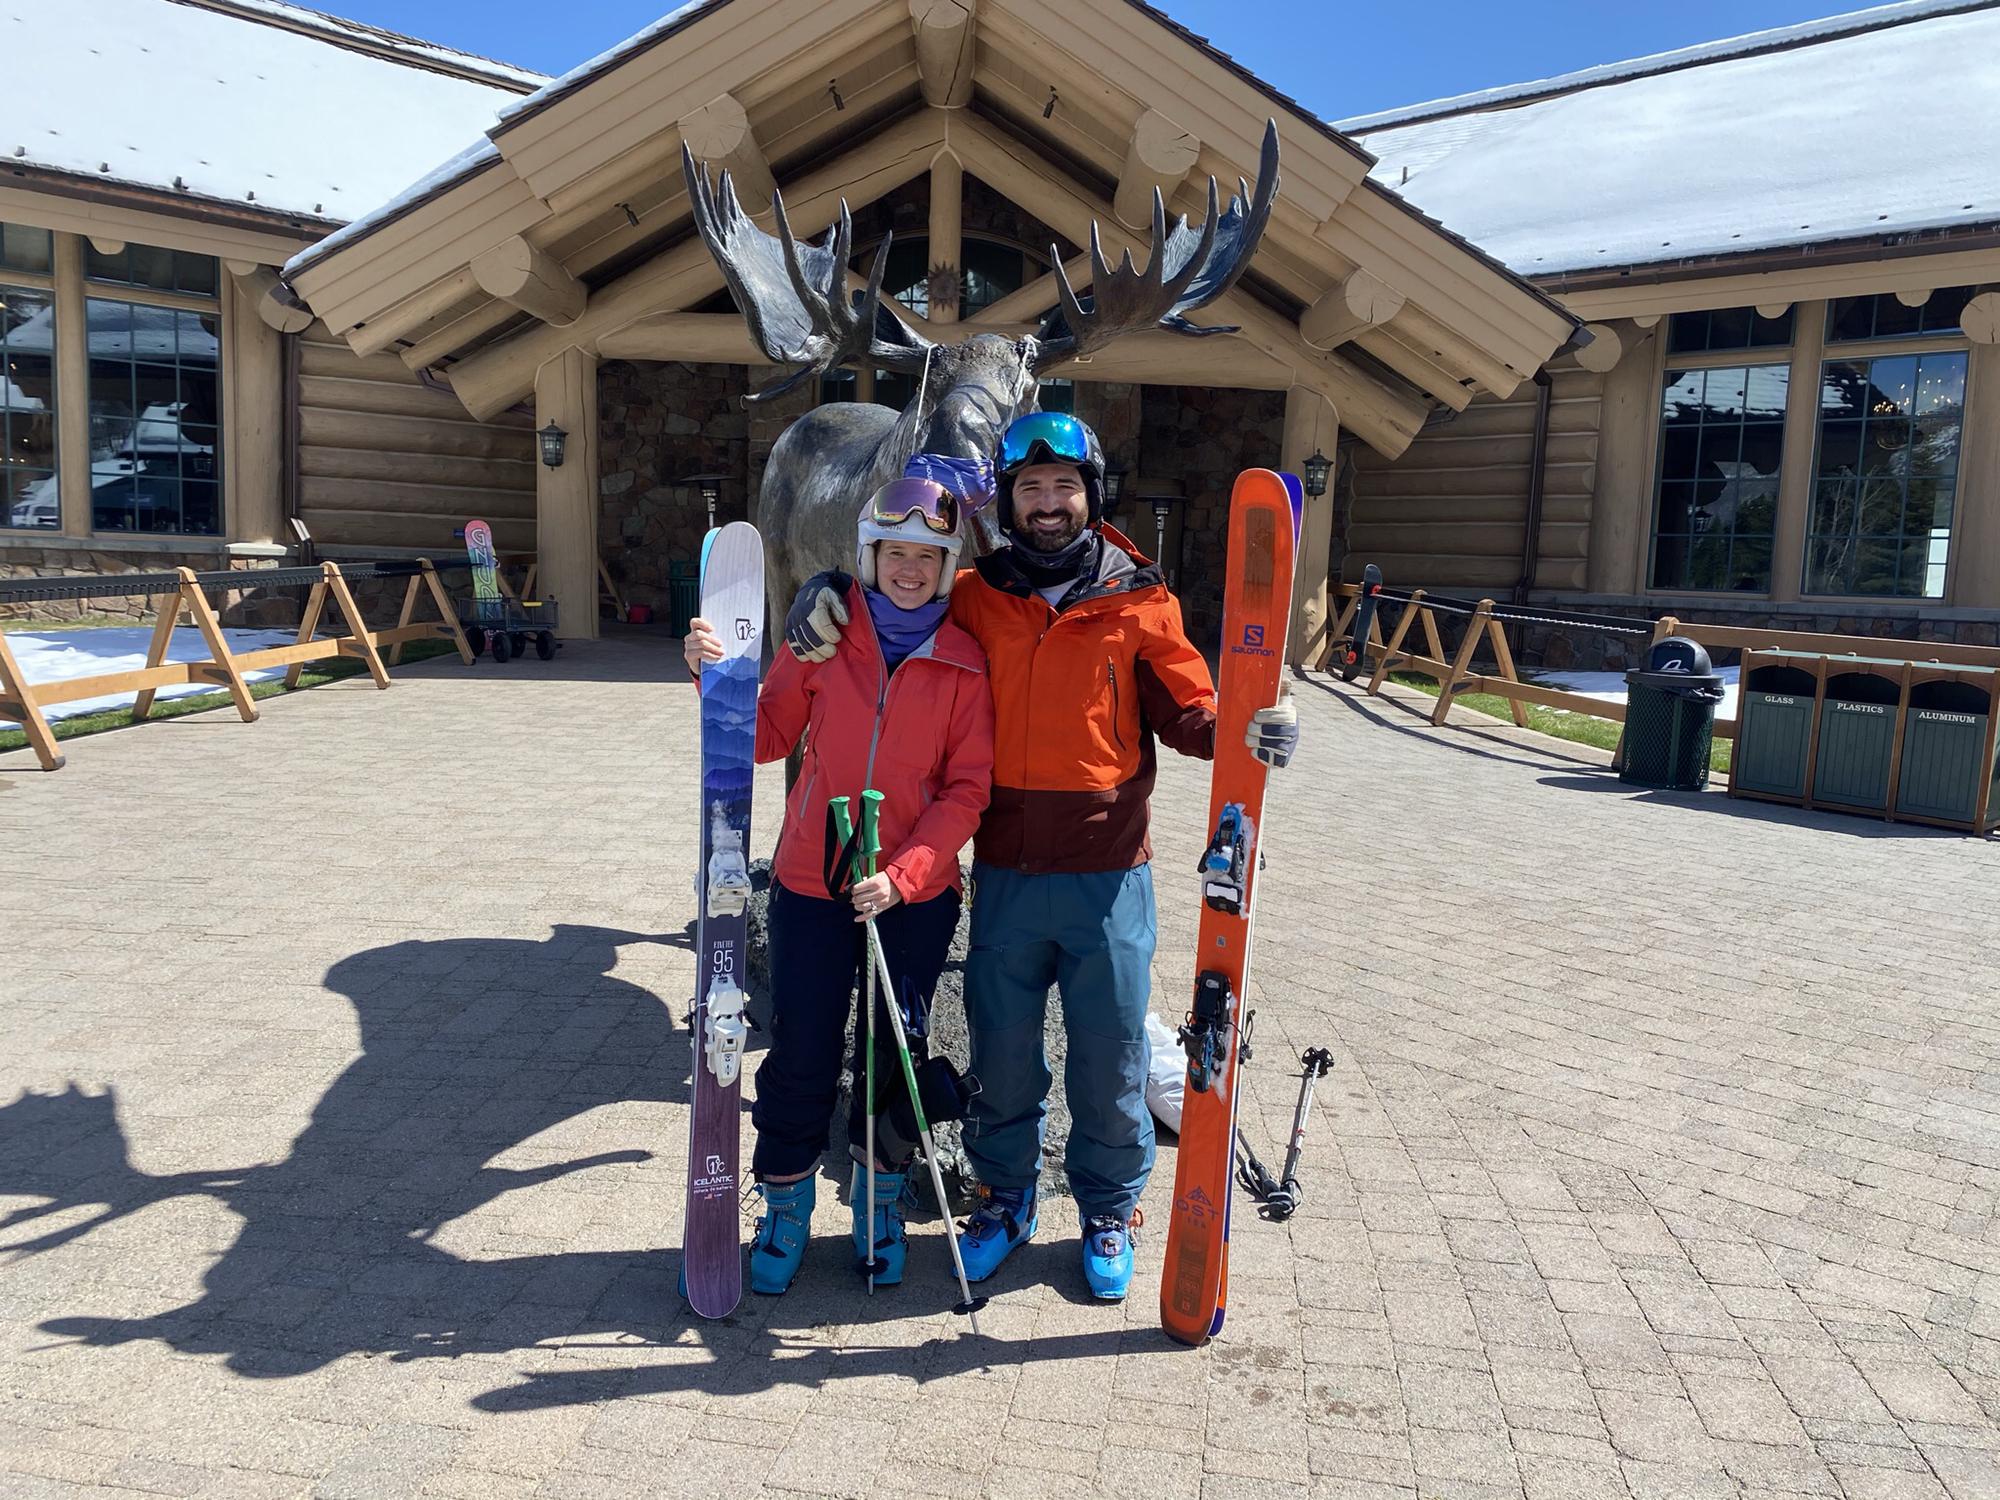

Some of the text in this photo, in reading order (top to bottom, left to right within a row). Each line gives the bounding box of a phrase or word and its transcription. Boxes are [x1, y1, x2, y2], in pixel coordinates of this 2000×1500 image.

[1764, 695, 1794, 705] GLASS
[1836, 702, 1885, 714] PLASTICS
[1918, 711, 1976, 724] ALUMINUM
[713, 950, 733, 973] 95
[693, 1175, 733, 1187] ICELANTIC
[1176, 1199, 1219, 1222] QST
